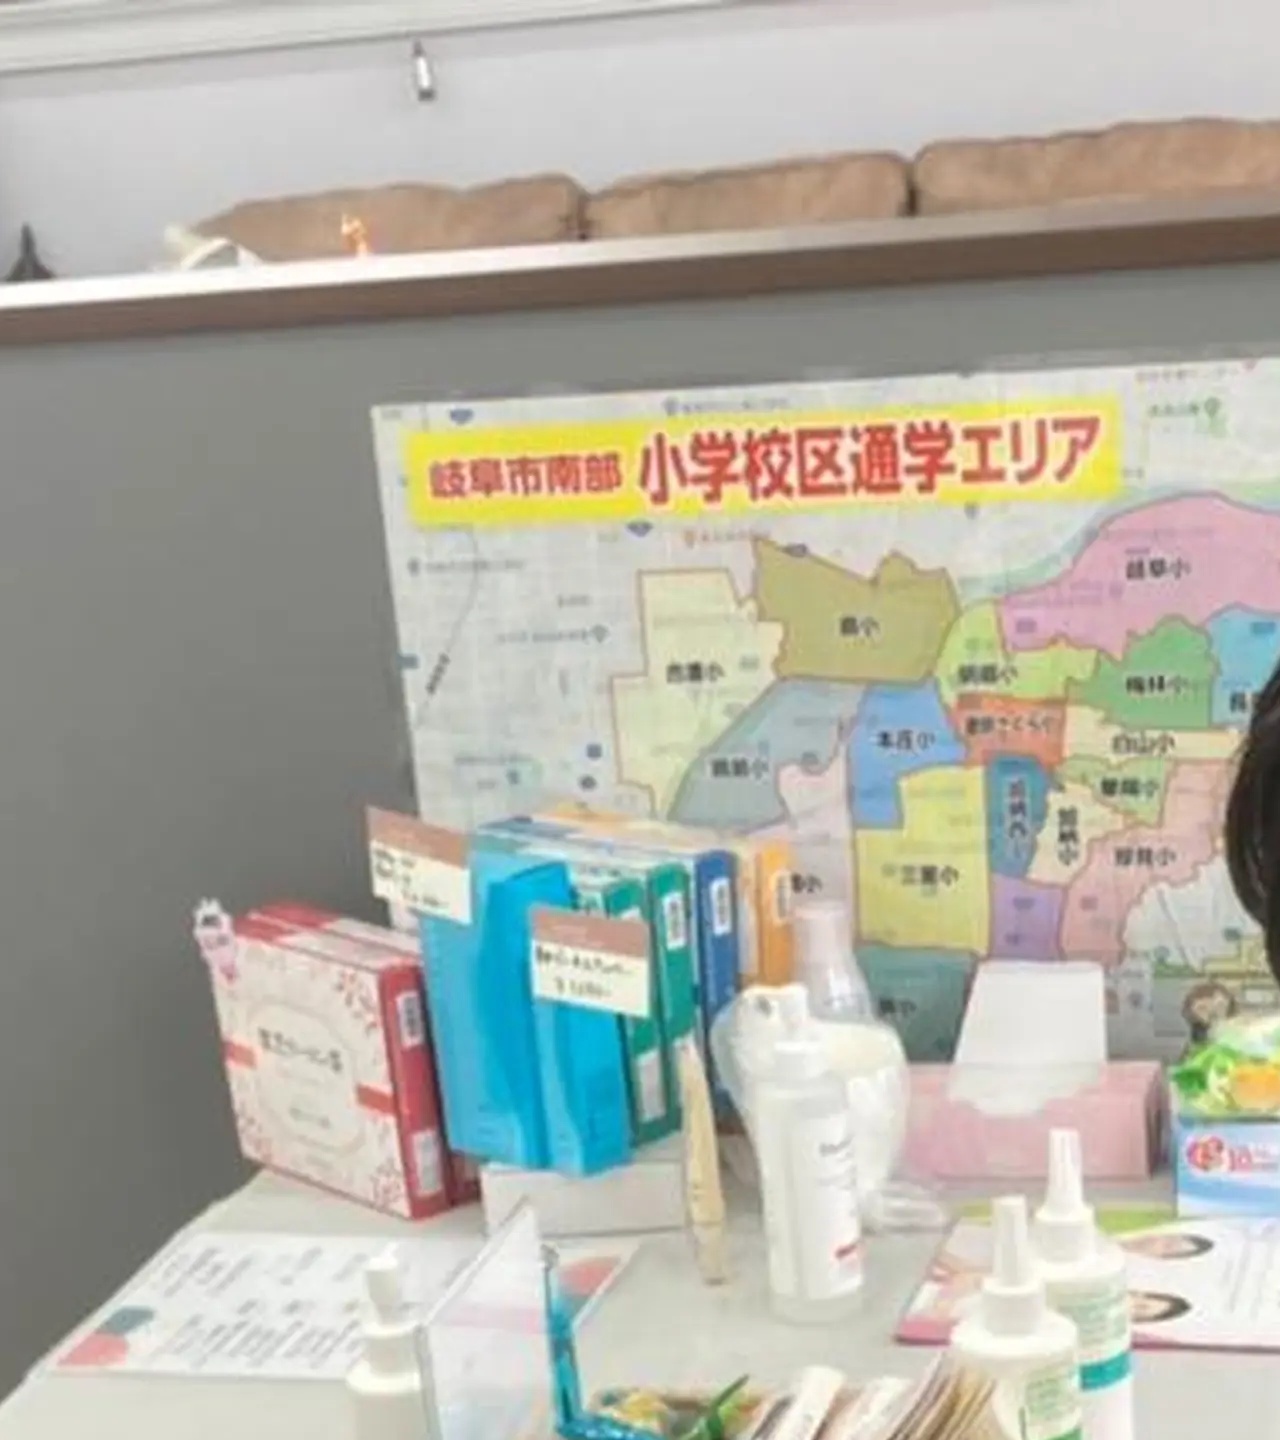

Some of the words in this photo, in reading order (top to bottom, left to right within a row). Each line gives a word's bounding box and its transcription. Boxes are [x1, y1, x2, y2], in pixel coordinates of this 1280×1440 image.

[429, 452, 623, 500] 岐阜市南部
[639, 416, 1101, 508] 小学校区通学エリア
